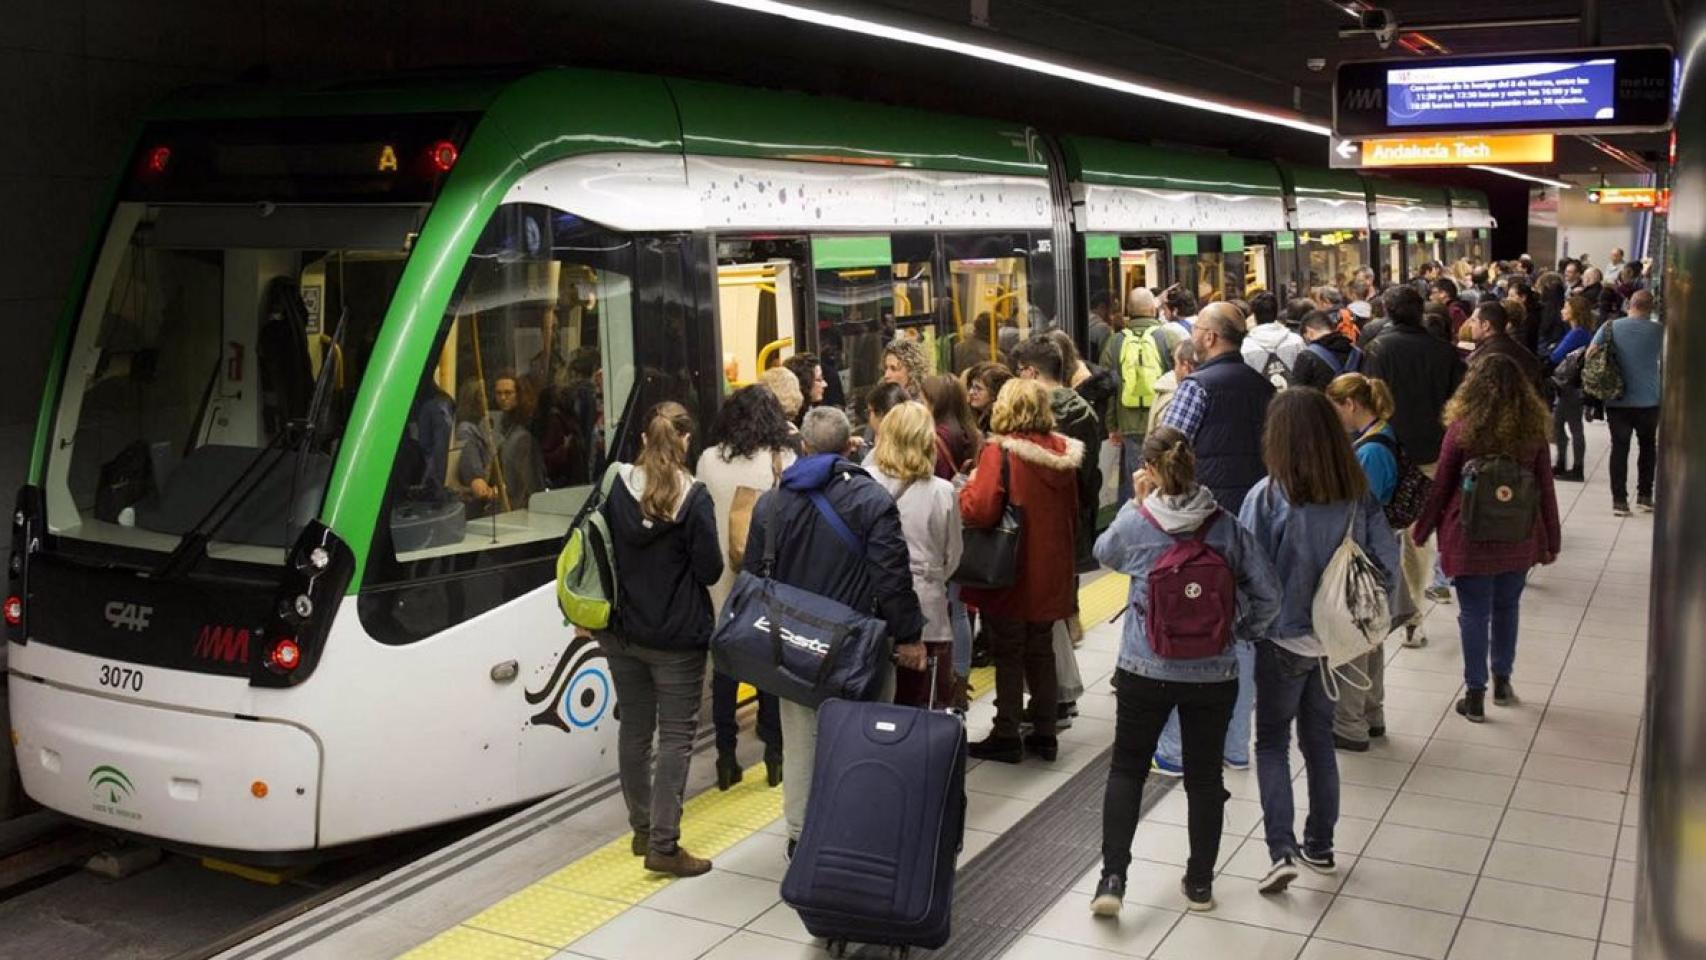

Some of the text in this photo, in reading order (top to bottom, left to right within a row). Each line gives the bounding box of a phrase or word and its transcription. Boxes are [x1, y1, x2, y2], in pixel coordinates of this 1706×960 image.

[1409, 84, 1424, 92] Con
[378, 144, 398, 171] A
[1373, 141, 1490, 159] Andalucía Tech
[105, 601, 153, 632] CAF
[99, 665, 143, 692] 3070
